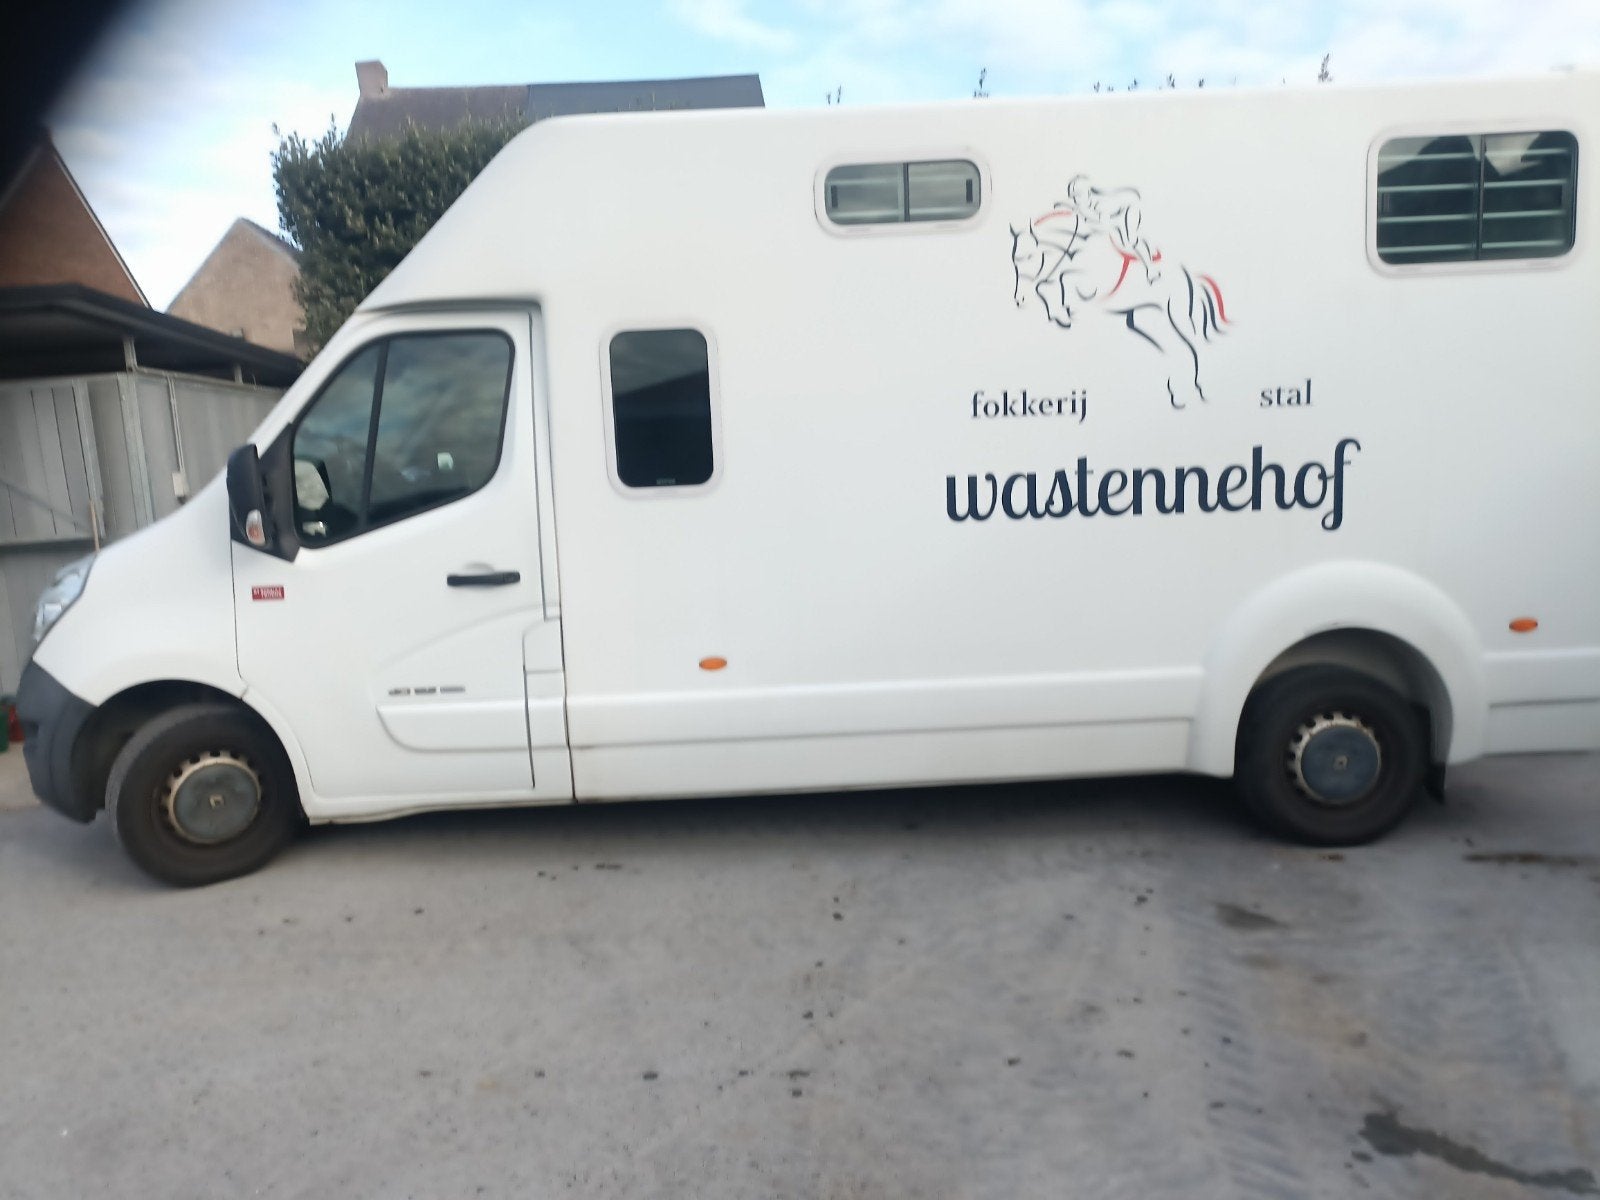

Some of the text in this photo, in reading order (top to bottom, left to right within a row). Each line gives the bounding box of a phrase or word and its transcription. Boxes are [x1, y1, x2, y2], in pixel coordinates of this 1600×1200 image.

[971, 378, 1313, 423] fokkerij stal
[946, 438, 1362, 531] wastennehof
